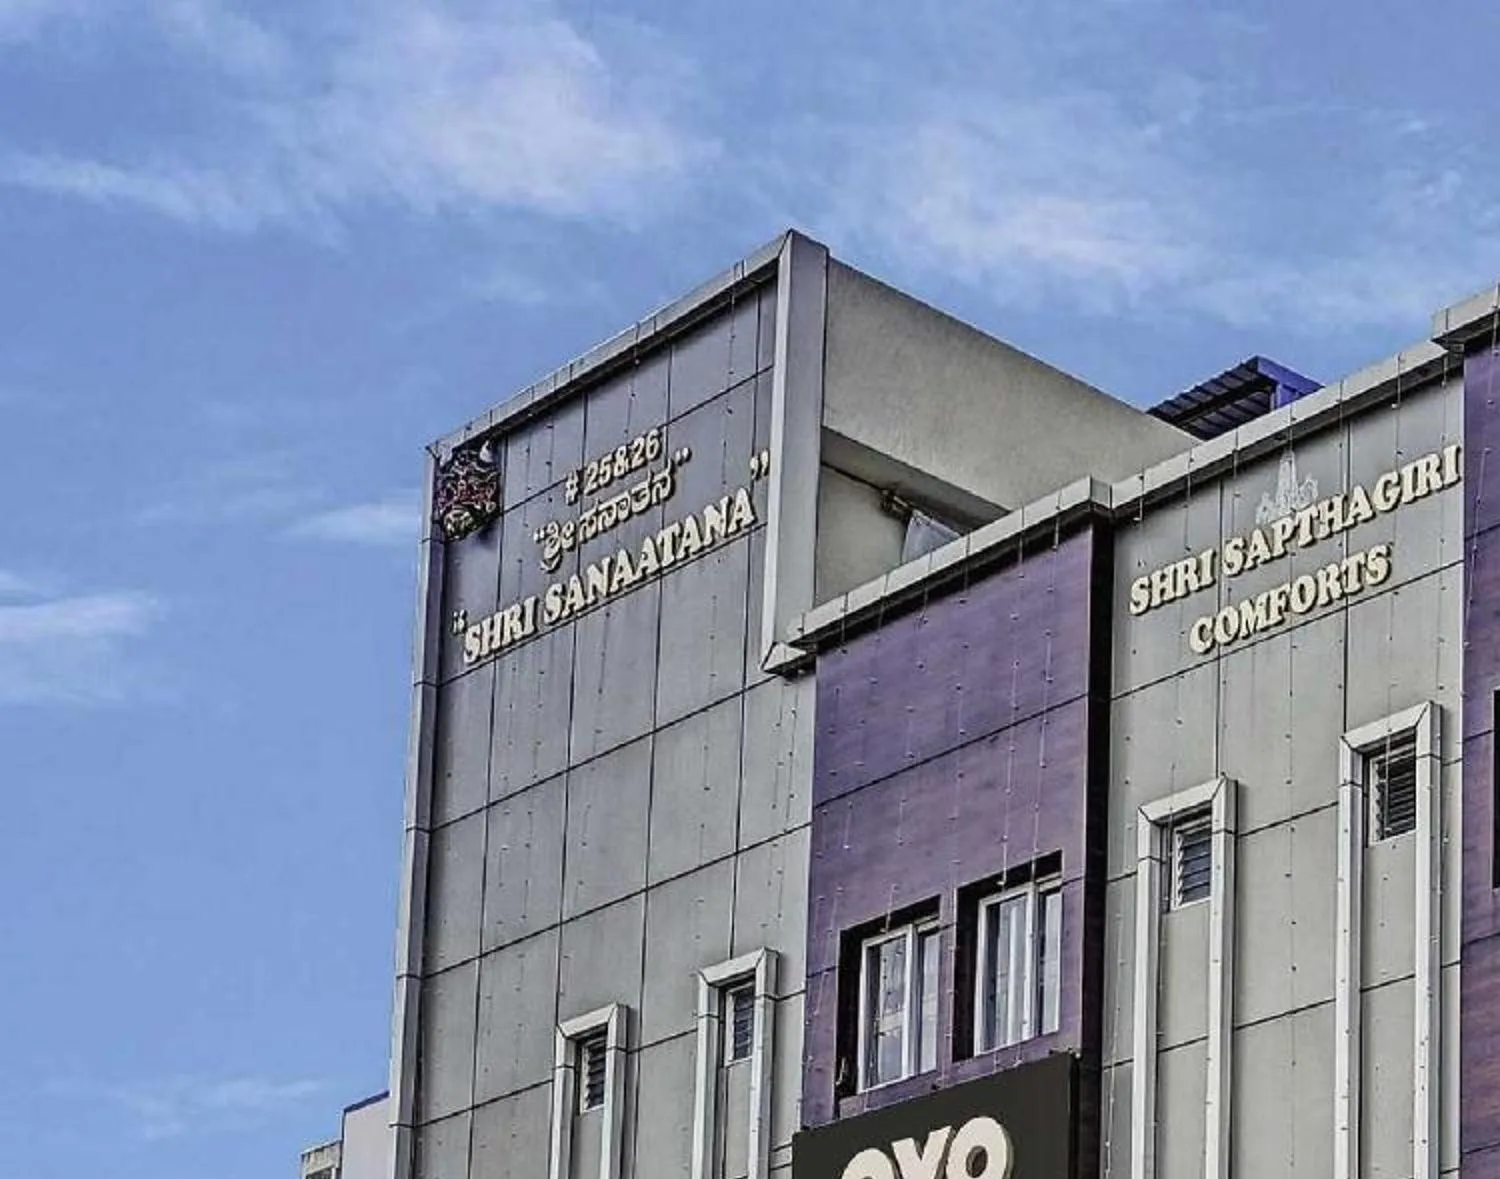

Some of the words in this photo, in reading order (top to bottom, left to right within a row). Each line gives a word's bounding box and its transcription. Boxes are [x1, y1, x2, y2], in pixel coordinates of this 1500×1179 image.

[1130, 550, 1216, 615] SHRI
[1222, 445, 1461, 576] SAPTHAGIRI
[1190, 545, 1390, 654] COMFORTS
